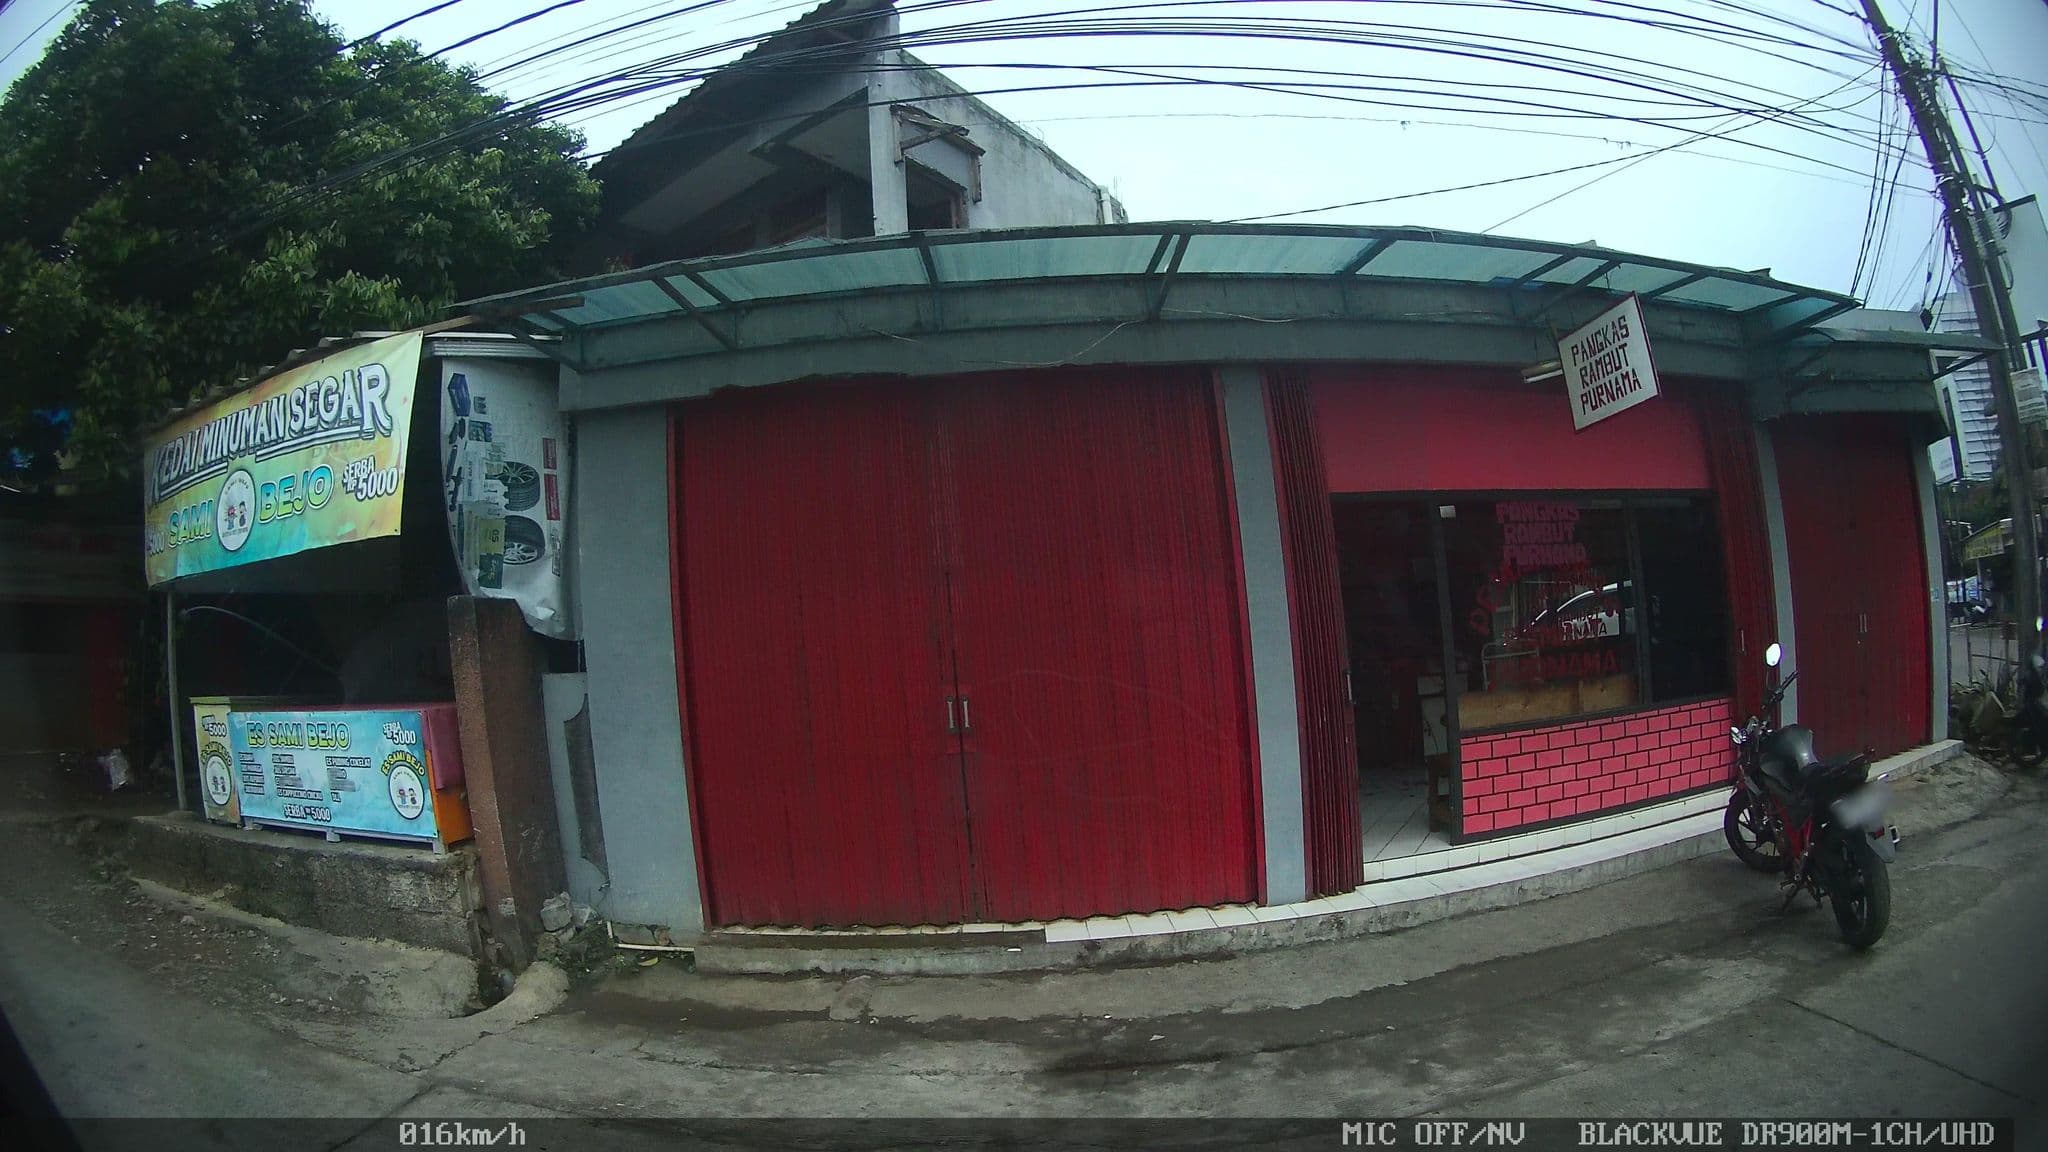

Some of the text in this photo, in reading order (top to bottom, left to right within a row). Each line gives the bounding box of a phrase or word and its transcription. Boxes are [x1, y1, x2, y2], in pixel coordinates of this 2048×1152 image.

[1571, 315, 1630, 367] PANGKAS
[1580, 343, 1629, 389] RAMBUT
[1581, 367, 1642, 415] PURNAMA
[151, 363, 393, 508] KEDAI MINUMAN SEGAR
[342, 455, 374, 484] SERBA
[355, 467, 399, 502] 5000
[168, 463, 335, 548] SAMI BEJO
[208, 722, 227, 737] 5000
[246, 721, 266, 748] ES
[267, 721, 304, 748] SAMI
[306, 722, 351, 750] BEJO
[392, 729, 417, 745] 5000
[283, 803, 307, 820] SERBA
[310, 806, 332, 822] 5000
